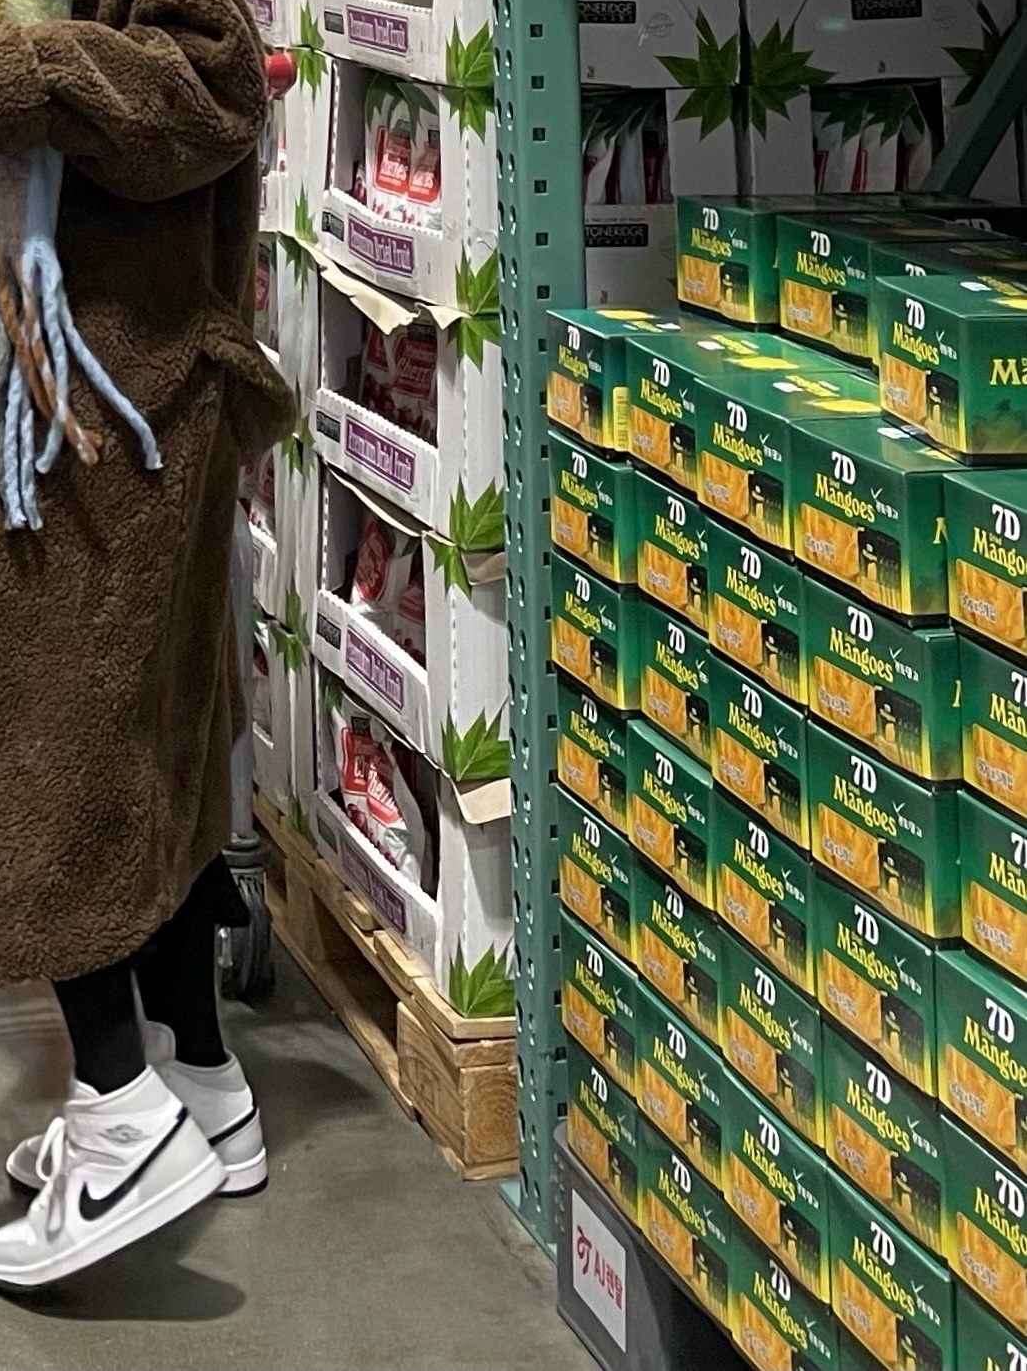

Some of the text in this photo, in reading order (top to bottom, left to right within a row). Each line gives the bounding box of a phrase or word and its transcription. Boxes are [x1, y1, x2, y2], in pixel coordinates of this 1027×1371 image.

[585, 226, 645, 237] TONERIDGE
[703, 208, 719, 231] 7D
[691, 228, 732, 257] Mangoes
[811, 231, 830, 257] 7D
[796, 252, 846, 286] Mangoes
[906, 298, 925, 330] 7D
[568, 325, 581, 350] 7D
[893, 321, 940, 366] Mangoes
[653, 359, 670, 387] 7D
[640, 378, 682, 418] Mangoes
[727, 401, 748, 432] 7D
[713, 422, 763, 466] Mangoes
[572, 451, 588, 479] 7D
[832, 451, 856, 485] 7D
[668, 496, 686, 526] 7D
[815, 473, 876, 523] Mangoes
[654, 514, 700, 559] Mangoes
[992, 503, 1021, 541] 7D
[741, 547, 762, 580] 7D
[575, 573, 591, 602] 7D
[726, 566, 777, 616] Mangoes
[668, 623, 686, 654] 7D
[848, 606, 874, 642] 7D
[655, 644, 699, 690] Mangoes
[830, 627, 894, 683] Mangoes
[581, 694, 598, 724] 7D
[742, 684, 763, 719] 7D
[729, 702, 778, 757] Mangoes
[656, 752, 674, 786] 7D
[851, 756, 877, 794] 7D
[643, 770, 687, 823] Mangoes
[834, 774, 897, 837] Mangoes
[584, 816, 601, 848] 7D
[749, 822, 769, 859] 7D
[733, 840, 785, 901] Mangoes
[665, 885, 684, 920] 7D
[651, 899, 697, 959] Mangoes
[855, 905, 879, 946] 7D
[587, 944, 604, 978] 7D
[838, 924, 899, 991] Mangoes
[755, 967, 776, 1007] 7D
[739, 983, 792, 1049] Mangoes
[986, 998, 1015, 1044] 7D
[667, 1023, 687, 1060] 7D
[591, 1066, 608, 1103] 7D
[653, 1037, 701, 1100] Mangoes
[866, 1062, 892, 1105] 7D
[759, 1115, 780, 1157] 7D
[847, 1081, 911, 1154] Mangoes
[672, 1155, 692, 1194] 7D
[743, 1130, 796, 1202] Mangoes
[658, 1169, 707, 1238] Mangoes
[995, 1170, 1024, 1218] 7D
[871, 1221, 896, 1267] 7D
[594, 1248, 623, 1310] AJ렌탈
[770, 1259, 791, 1302] 7D
[853, 1236, 915, 1317] Mangoes
[754, 1271, 808, 1350] Mangoes
